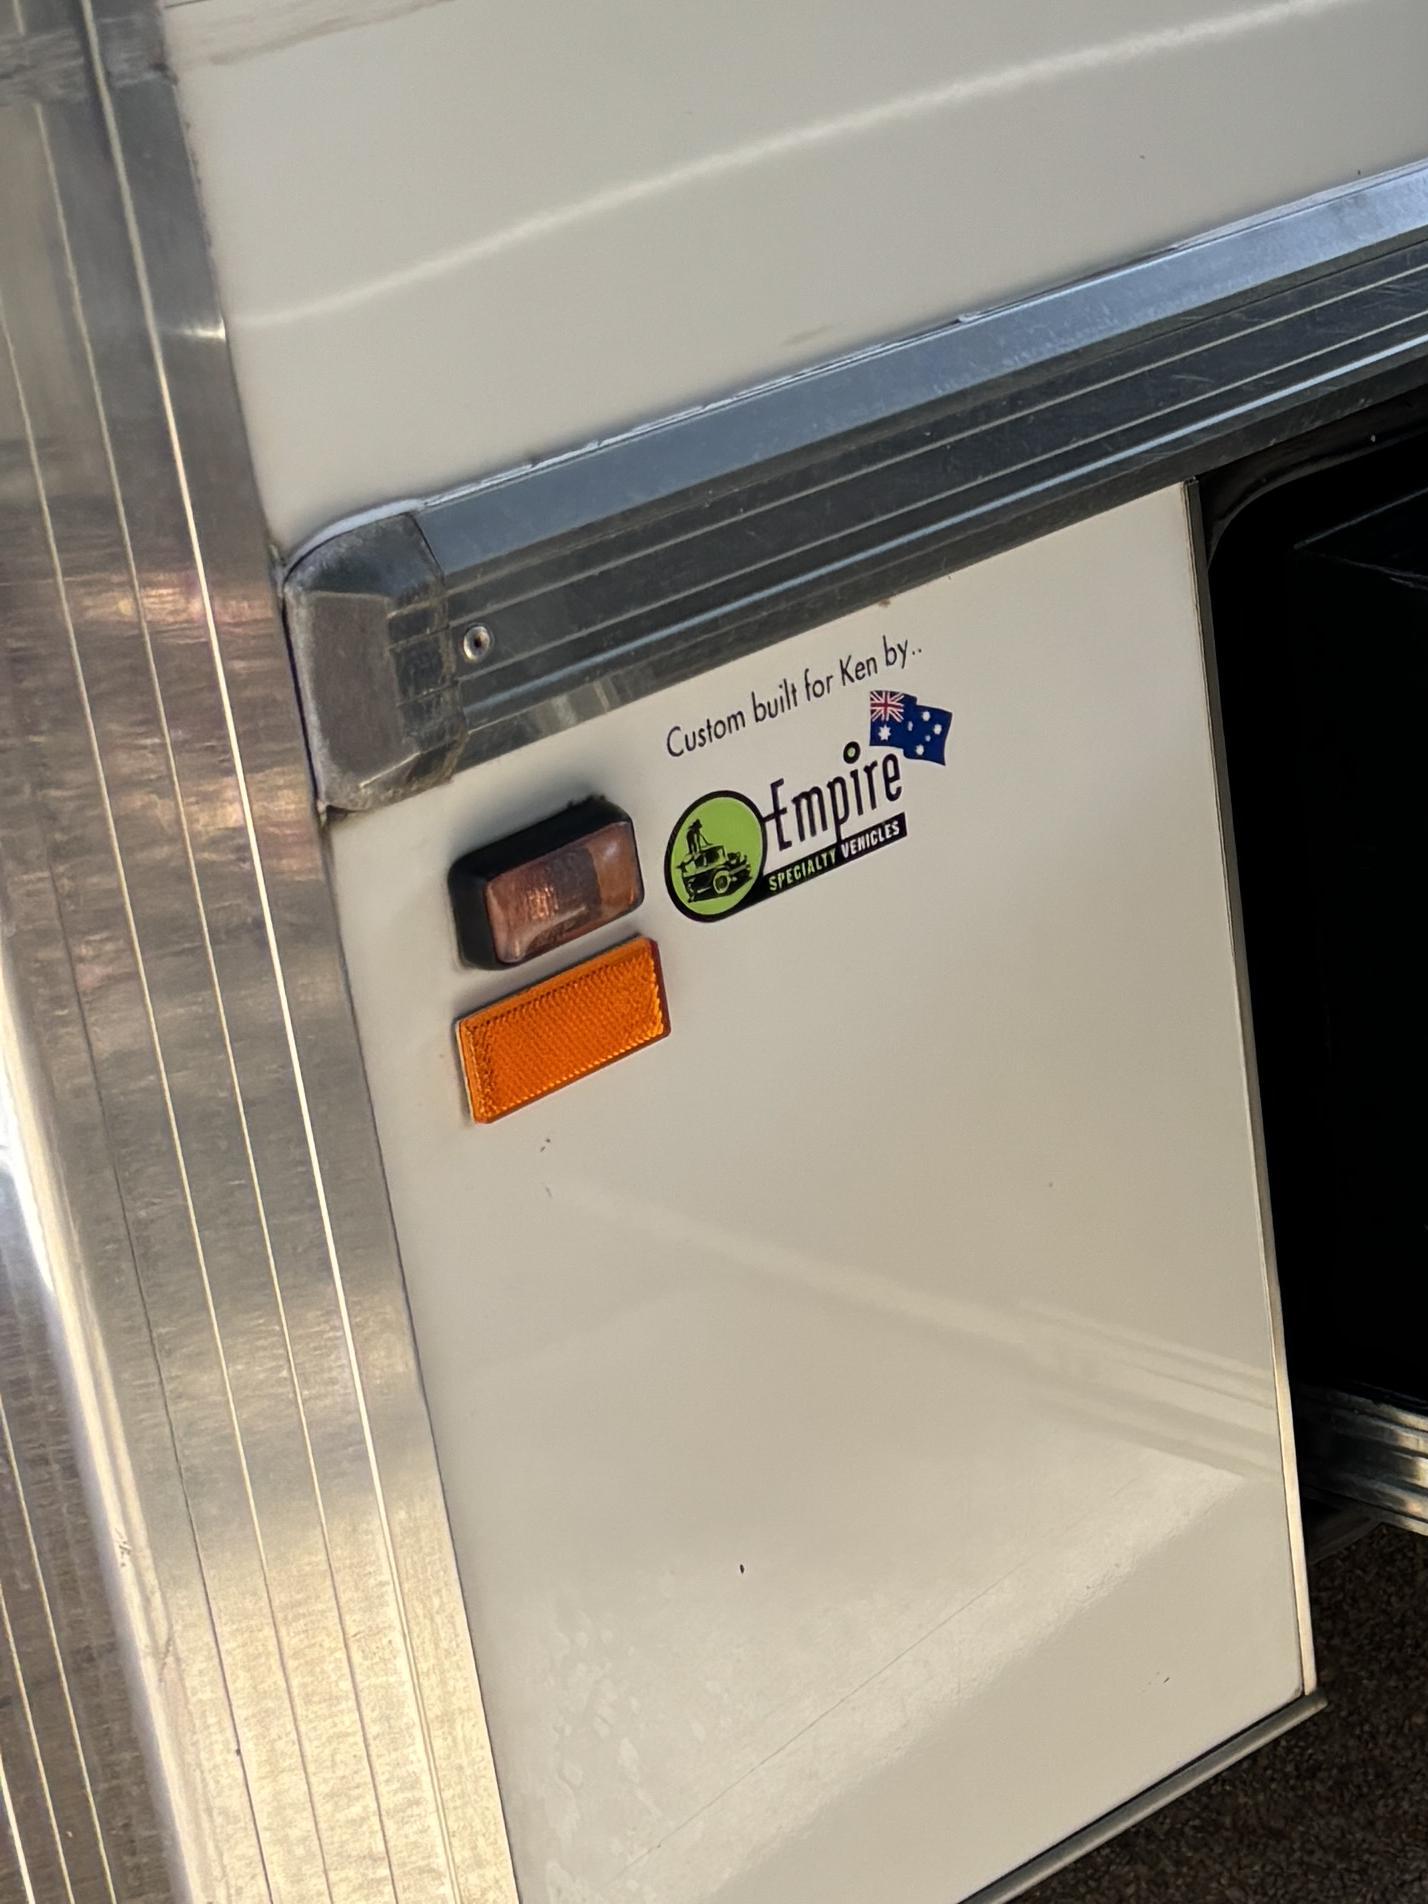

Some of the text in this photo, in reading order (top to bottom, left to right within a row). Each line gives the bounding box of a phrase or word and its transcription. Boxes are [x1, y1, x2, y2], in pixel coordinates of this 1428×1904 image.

[666, 709, 746, 757] Custom
[751, 678, 799, 723] built
[804, 668, 834, 701] for
[839, 654, 878, 687] Ken
[764, 741, 902, 851] Empire
[768, 820, 900, 891] SPECIALTY VEHICLES
